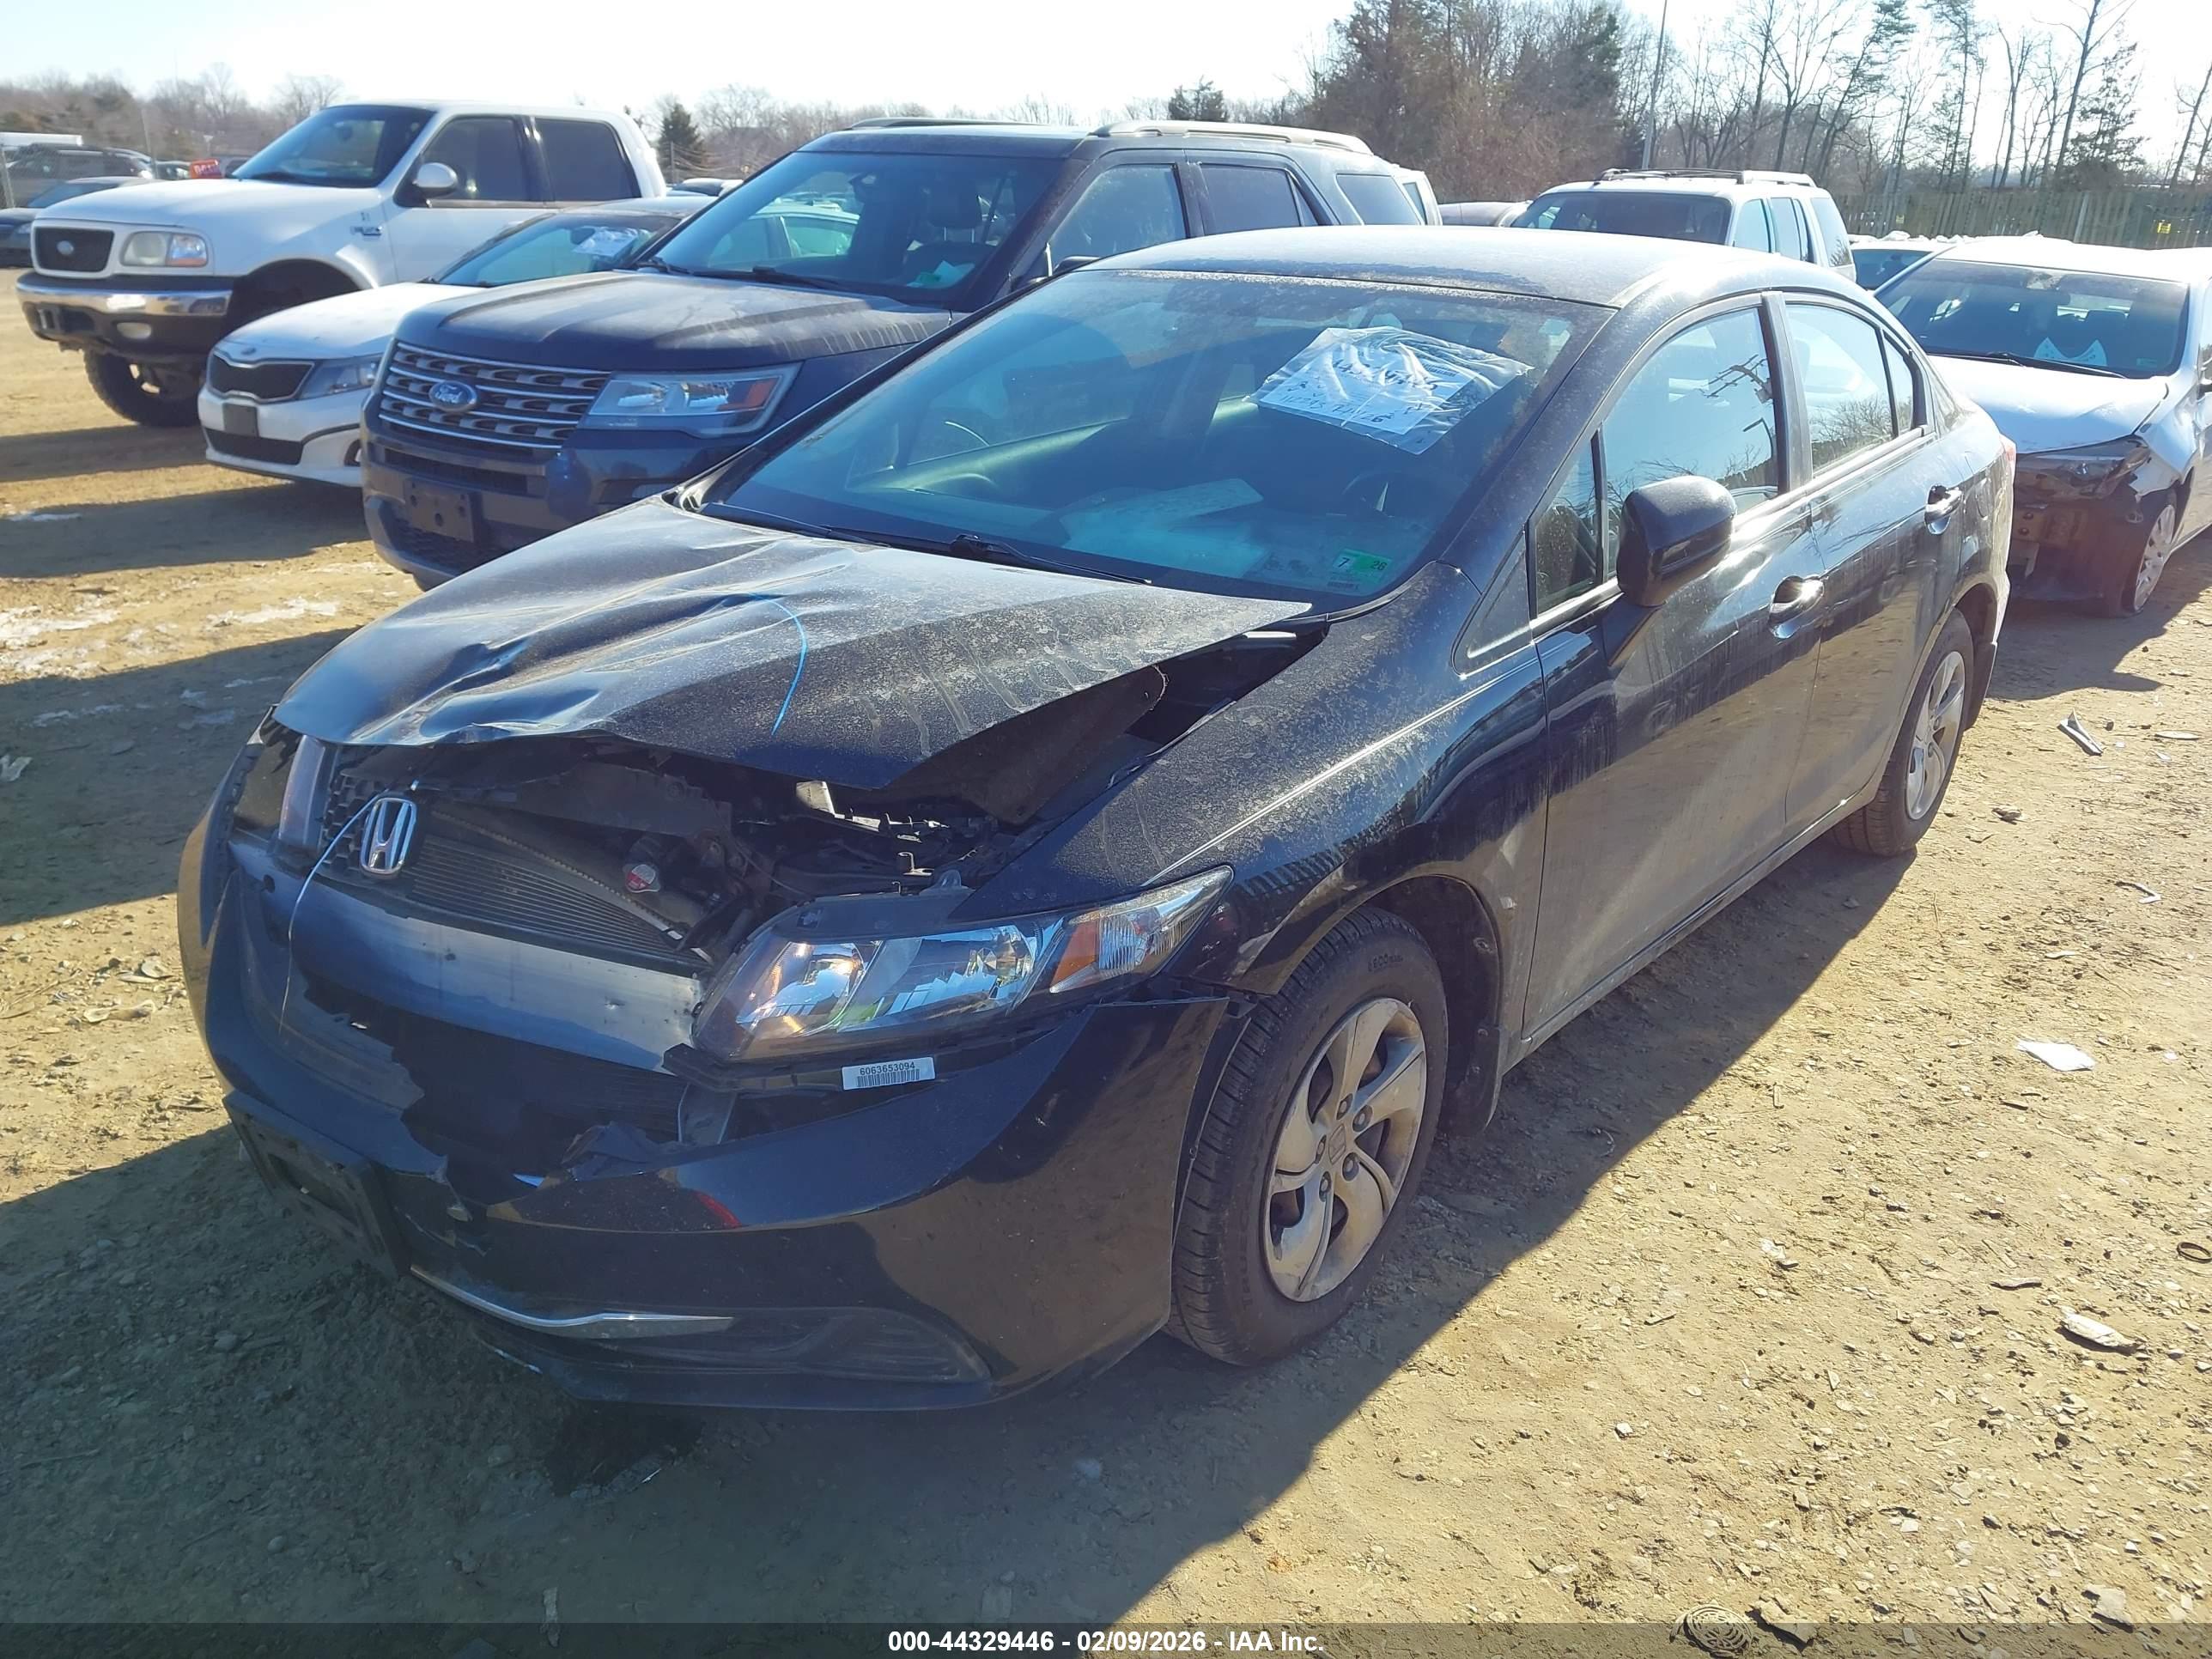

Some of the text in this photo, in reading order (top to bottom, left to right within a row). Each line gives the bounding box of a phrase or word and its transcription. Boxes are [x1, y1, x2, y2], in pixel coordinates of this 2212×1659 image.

[1339, 556, 1388, 571] 7 26
[860, 1061, 916, 1076] 6063653094
